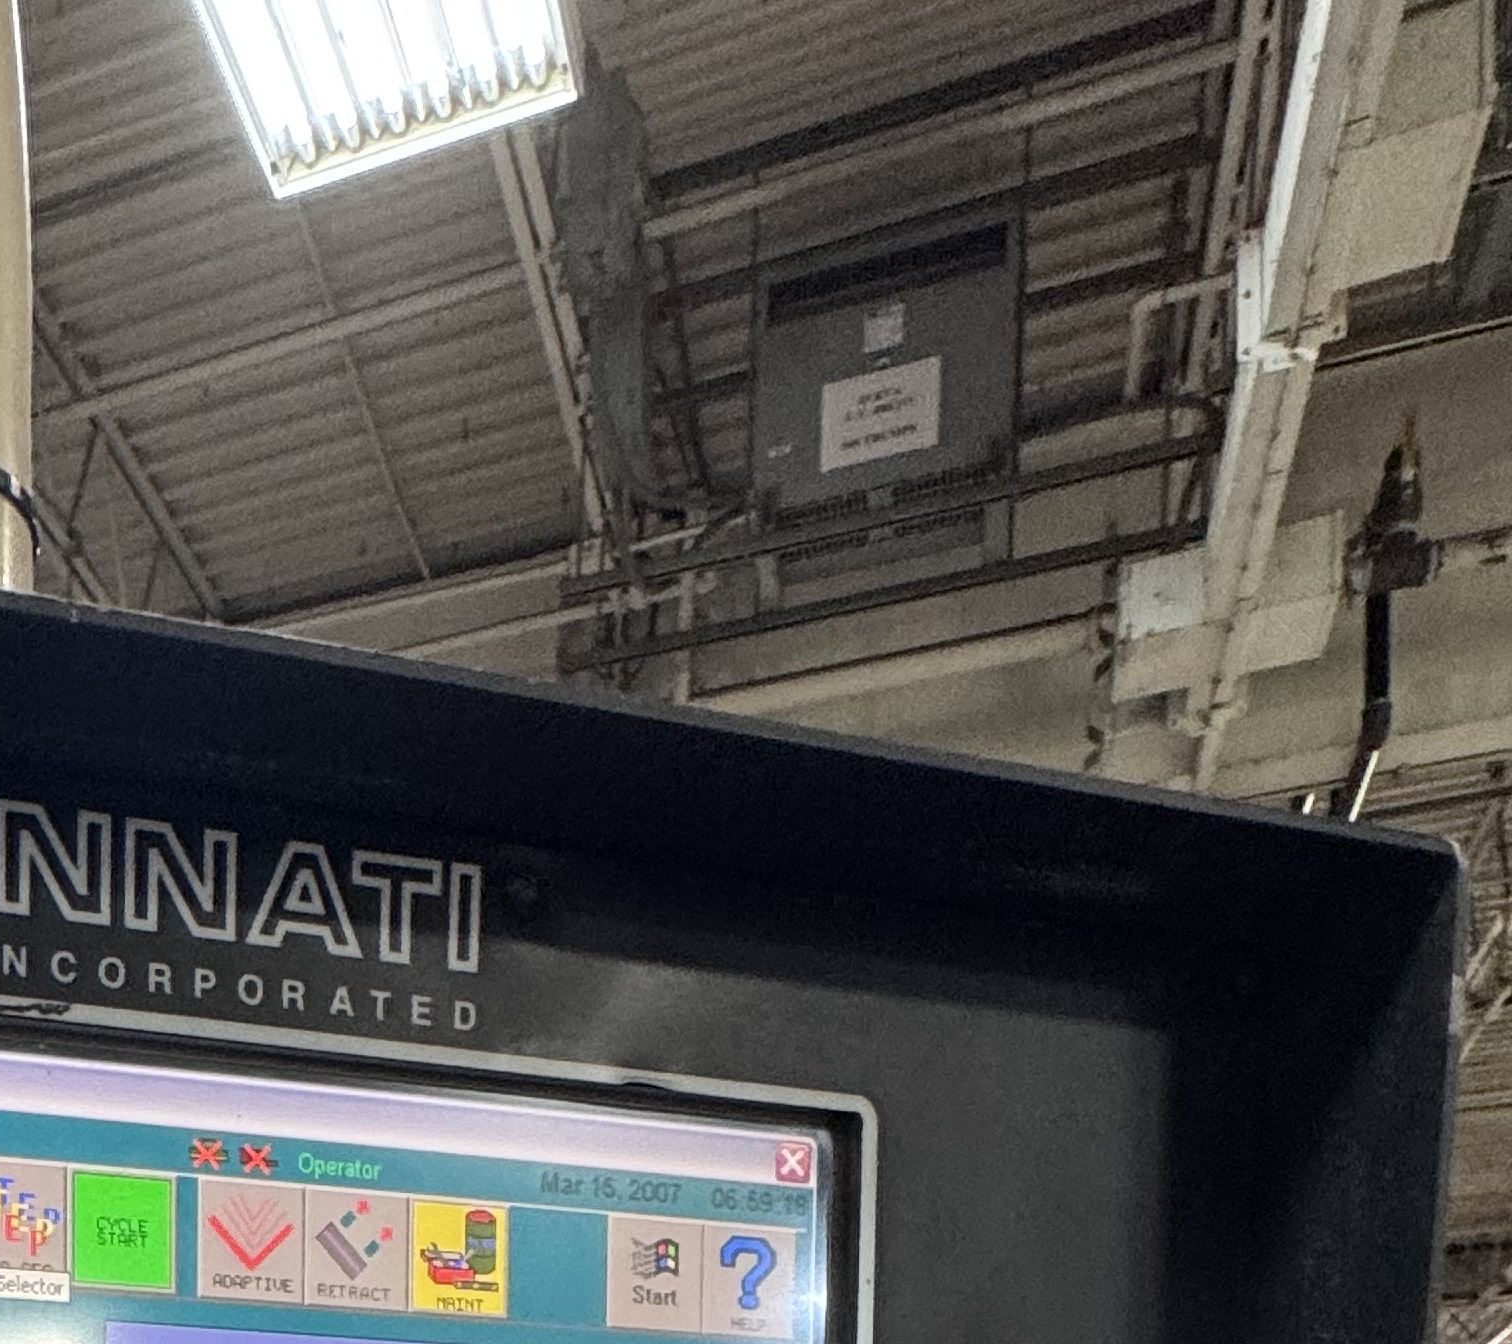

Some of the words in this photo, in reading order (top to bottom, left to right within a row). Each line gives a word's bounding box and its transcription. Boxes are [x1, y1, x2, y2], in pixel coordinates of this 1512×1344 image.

[298, 1152, 382, 1181] Operator
[628, 1178, 682, 1203] 2007
[96, 1216, 149, 1234] CYCLE
[96, 1231, 148, 1248] START
[212, 1273, 295, 1294] ADAPTIVE
[317, 1283, 391, 1301] RETRACT
[436, 1297, 484, 1313] MAINT
[632, 1285, 678, 1307] Start
[731, 1317, 766, 1332] HELP
